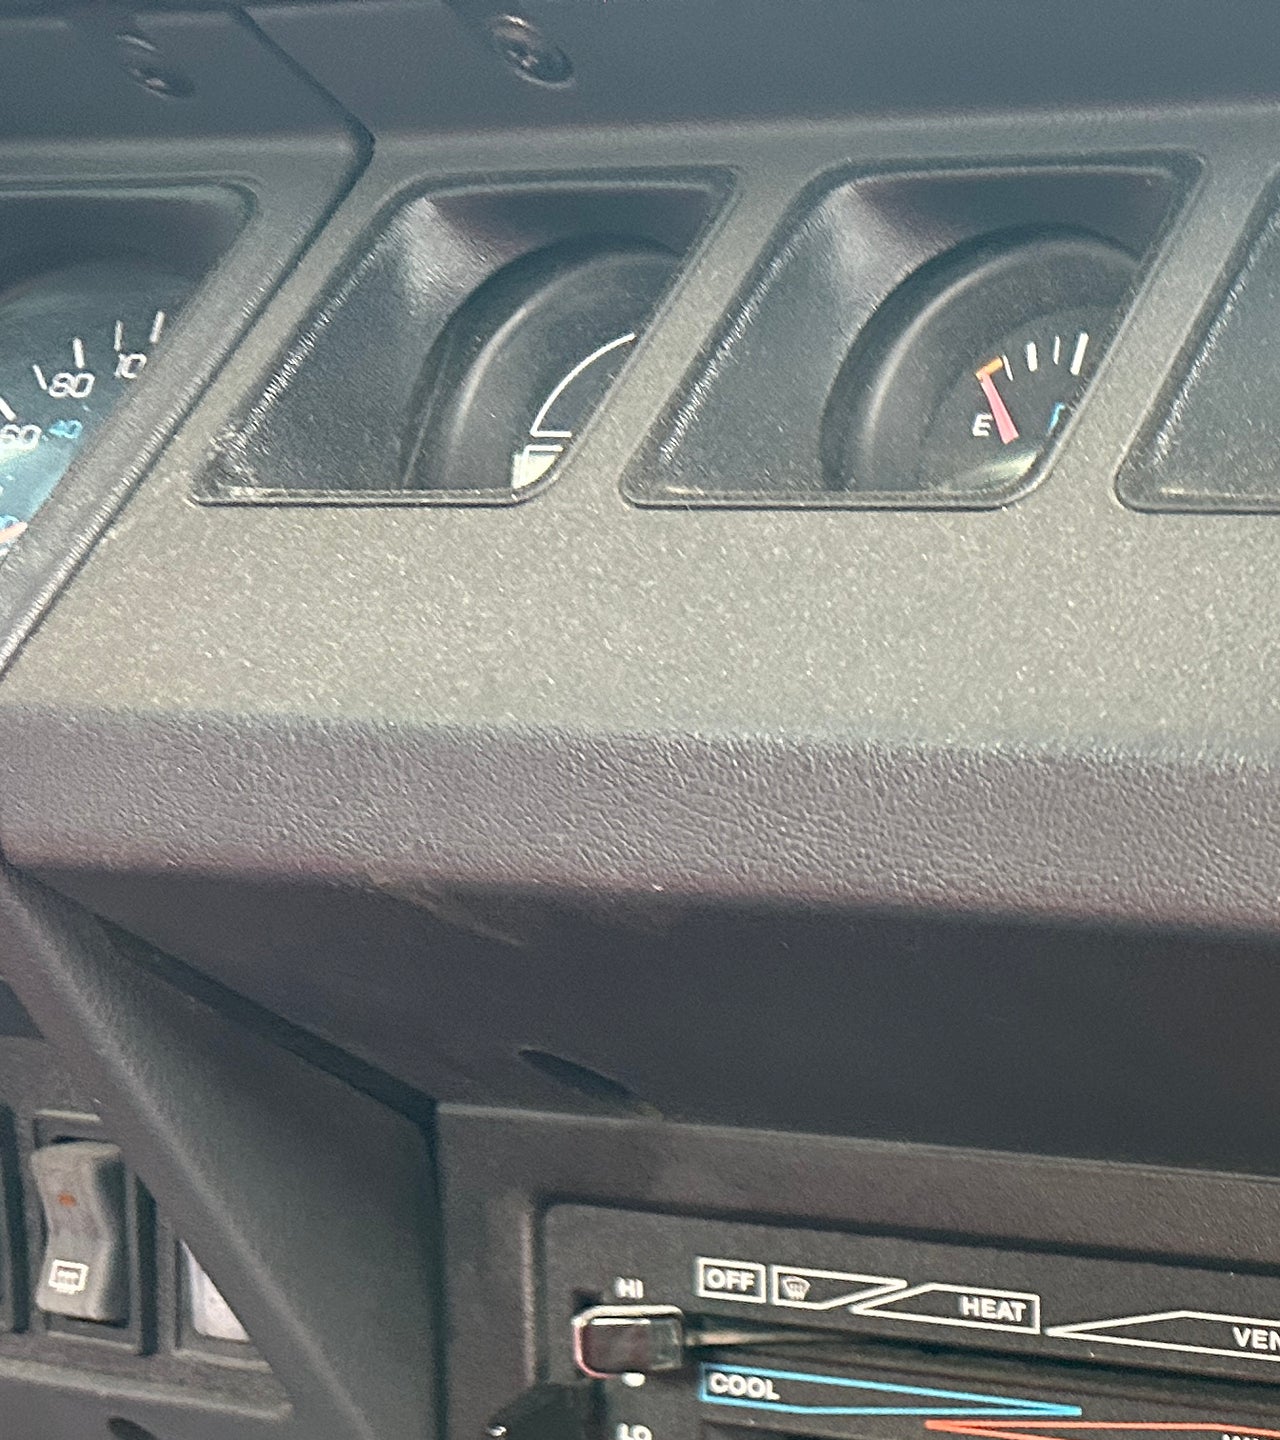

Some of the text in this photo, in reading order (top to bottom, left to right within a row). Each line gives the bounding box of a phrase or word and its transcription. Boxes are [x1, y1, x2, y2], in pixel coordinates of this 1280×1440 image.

[49, 372, 95, 398] 80
[0, 424, 42, 450] 60
[972, 414, 993, 437] E
[615, 1276, 643, 1299] HI
[706, 1270, 756, 1293] OFF
[959, 1296, 1027, 1324] HEAT
[708, 1372, 780, 1401] COOL
